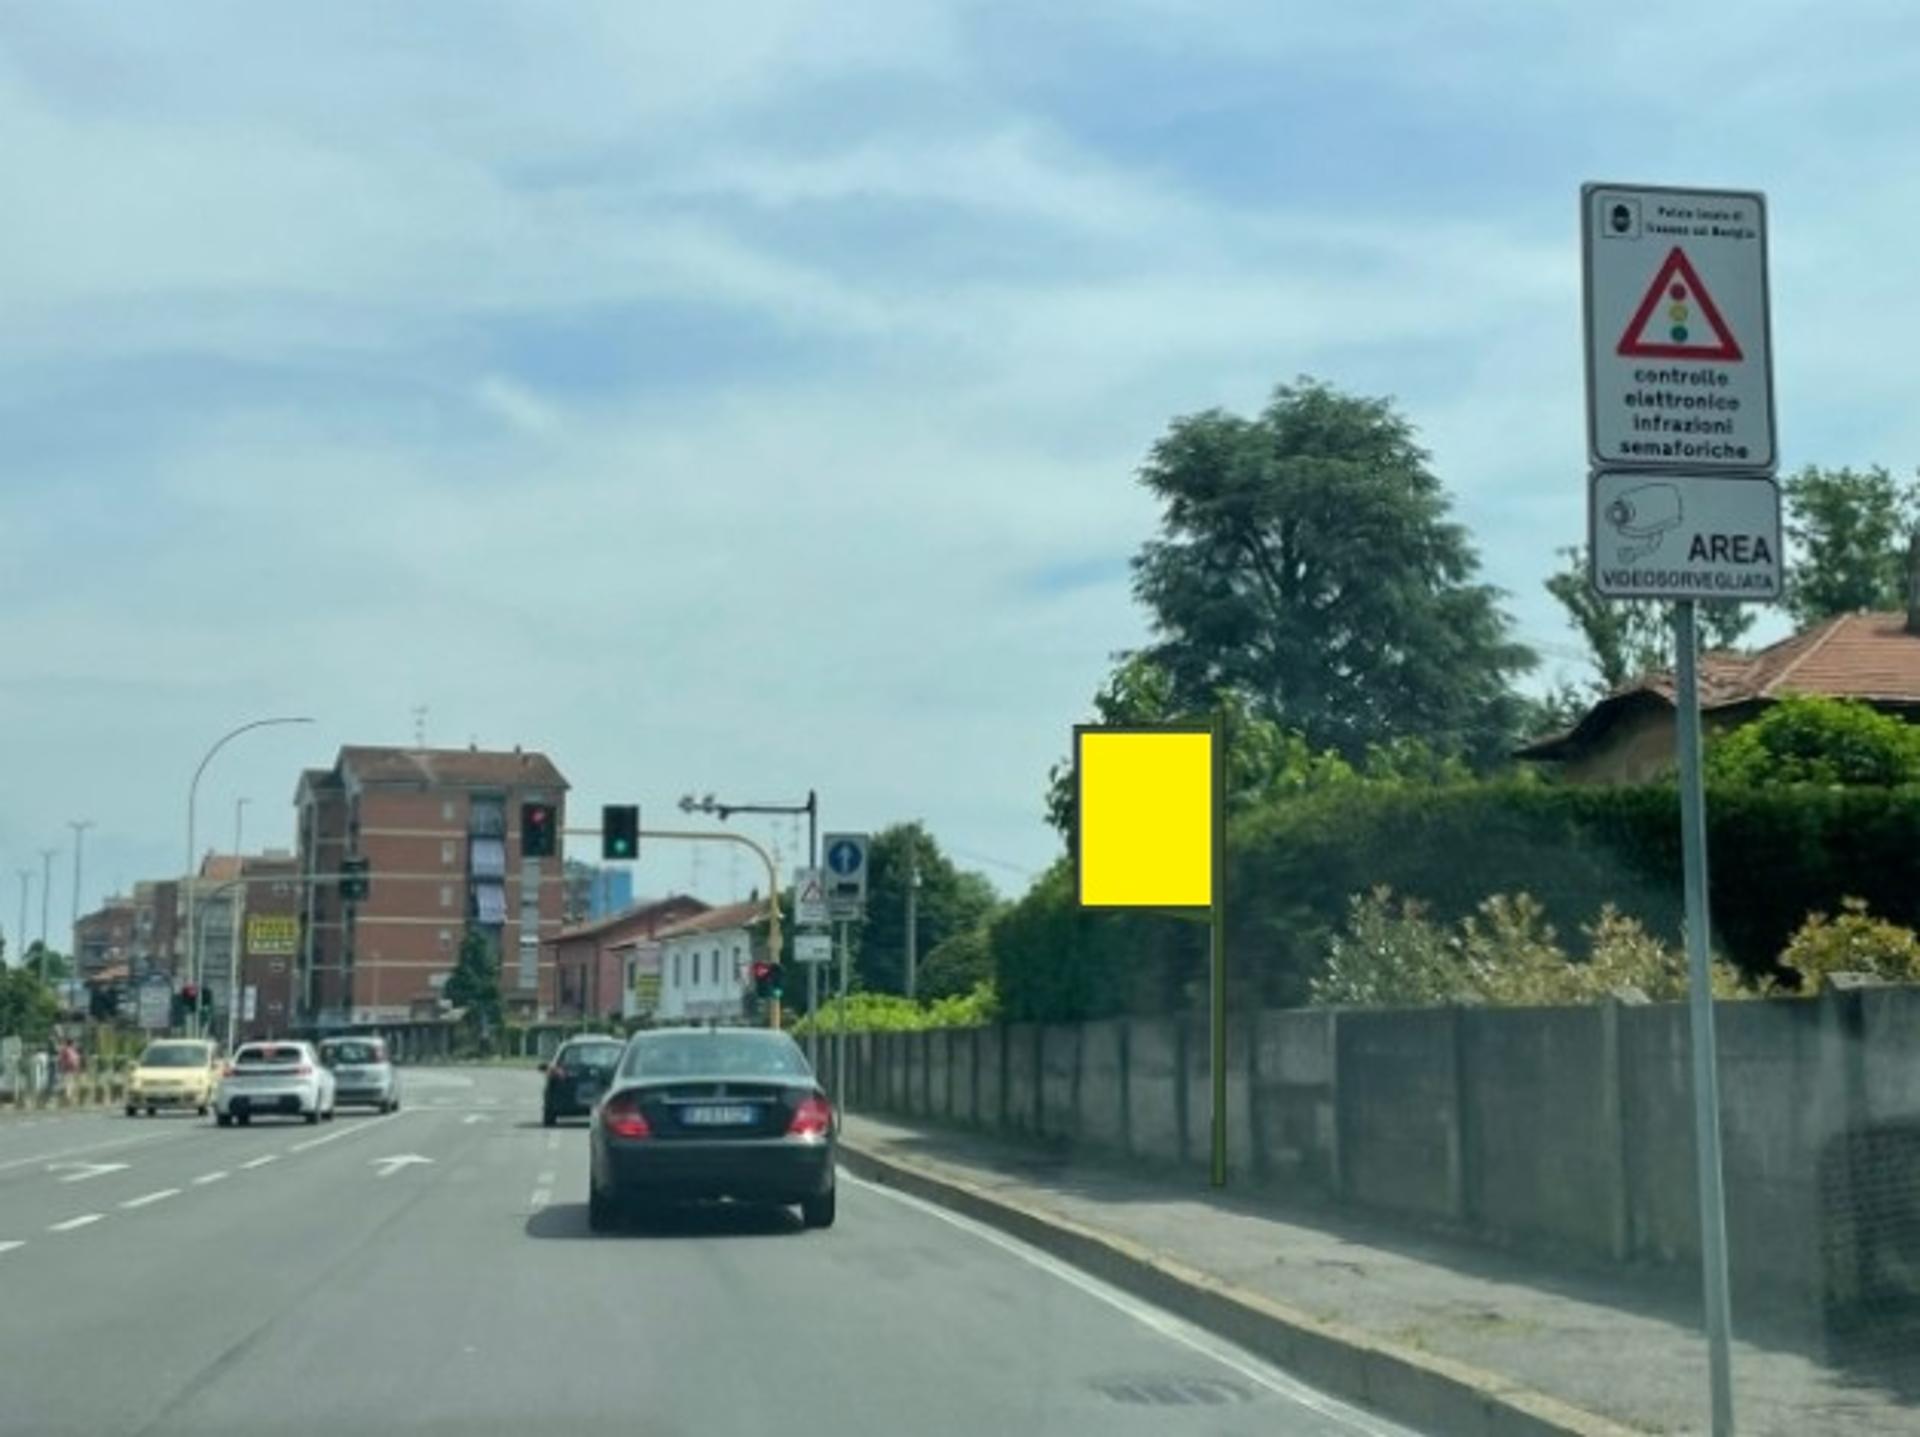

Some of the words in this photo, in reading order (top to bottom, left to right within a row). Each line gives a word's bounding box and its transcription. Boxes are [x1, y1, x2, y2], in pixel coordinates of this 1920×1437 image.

[1634, 368, 1729, 386] controllo
[1624, 389, 1740, 411] elettronico
[1633, 413, 1733, 434] infrazioni
[1620, 438, 1749, 459] semaforiche
[1688, 533, 1773, 565] AREA
[1602, 569, 1774, 592] VIDEOSORVEGLIATA
